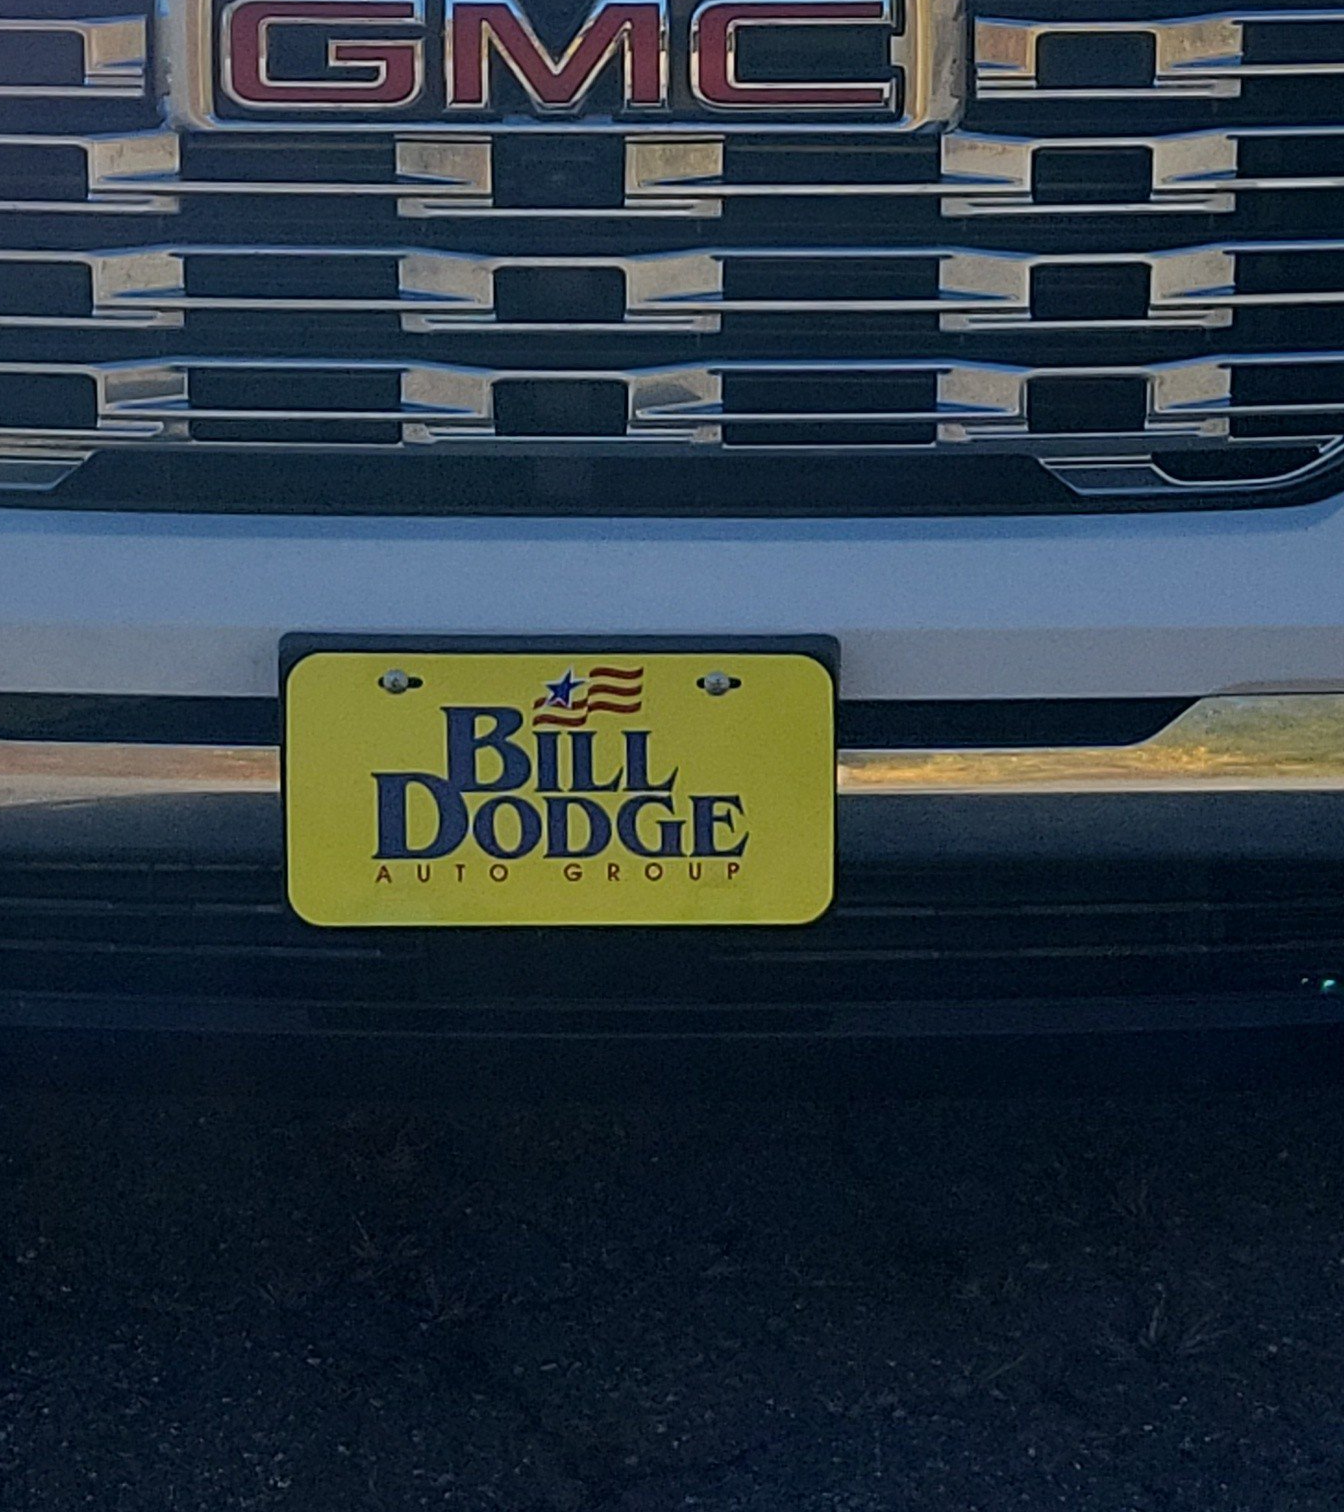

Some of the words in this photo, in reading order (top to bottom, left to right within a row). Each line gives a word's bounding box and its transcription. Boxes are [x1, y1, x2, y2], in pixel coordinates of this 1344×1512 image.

[439, 705, 680, 793] BILL
[371, 771, 750, 860] DODGE
[374, 862, 510, 885] AUTO
[563, 861, 741, 884] GROUP
